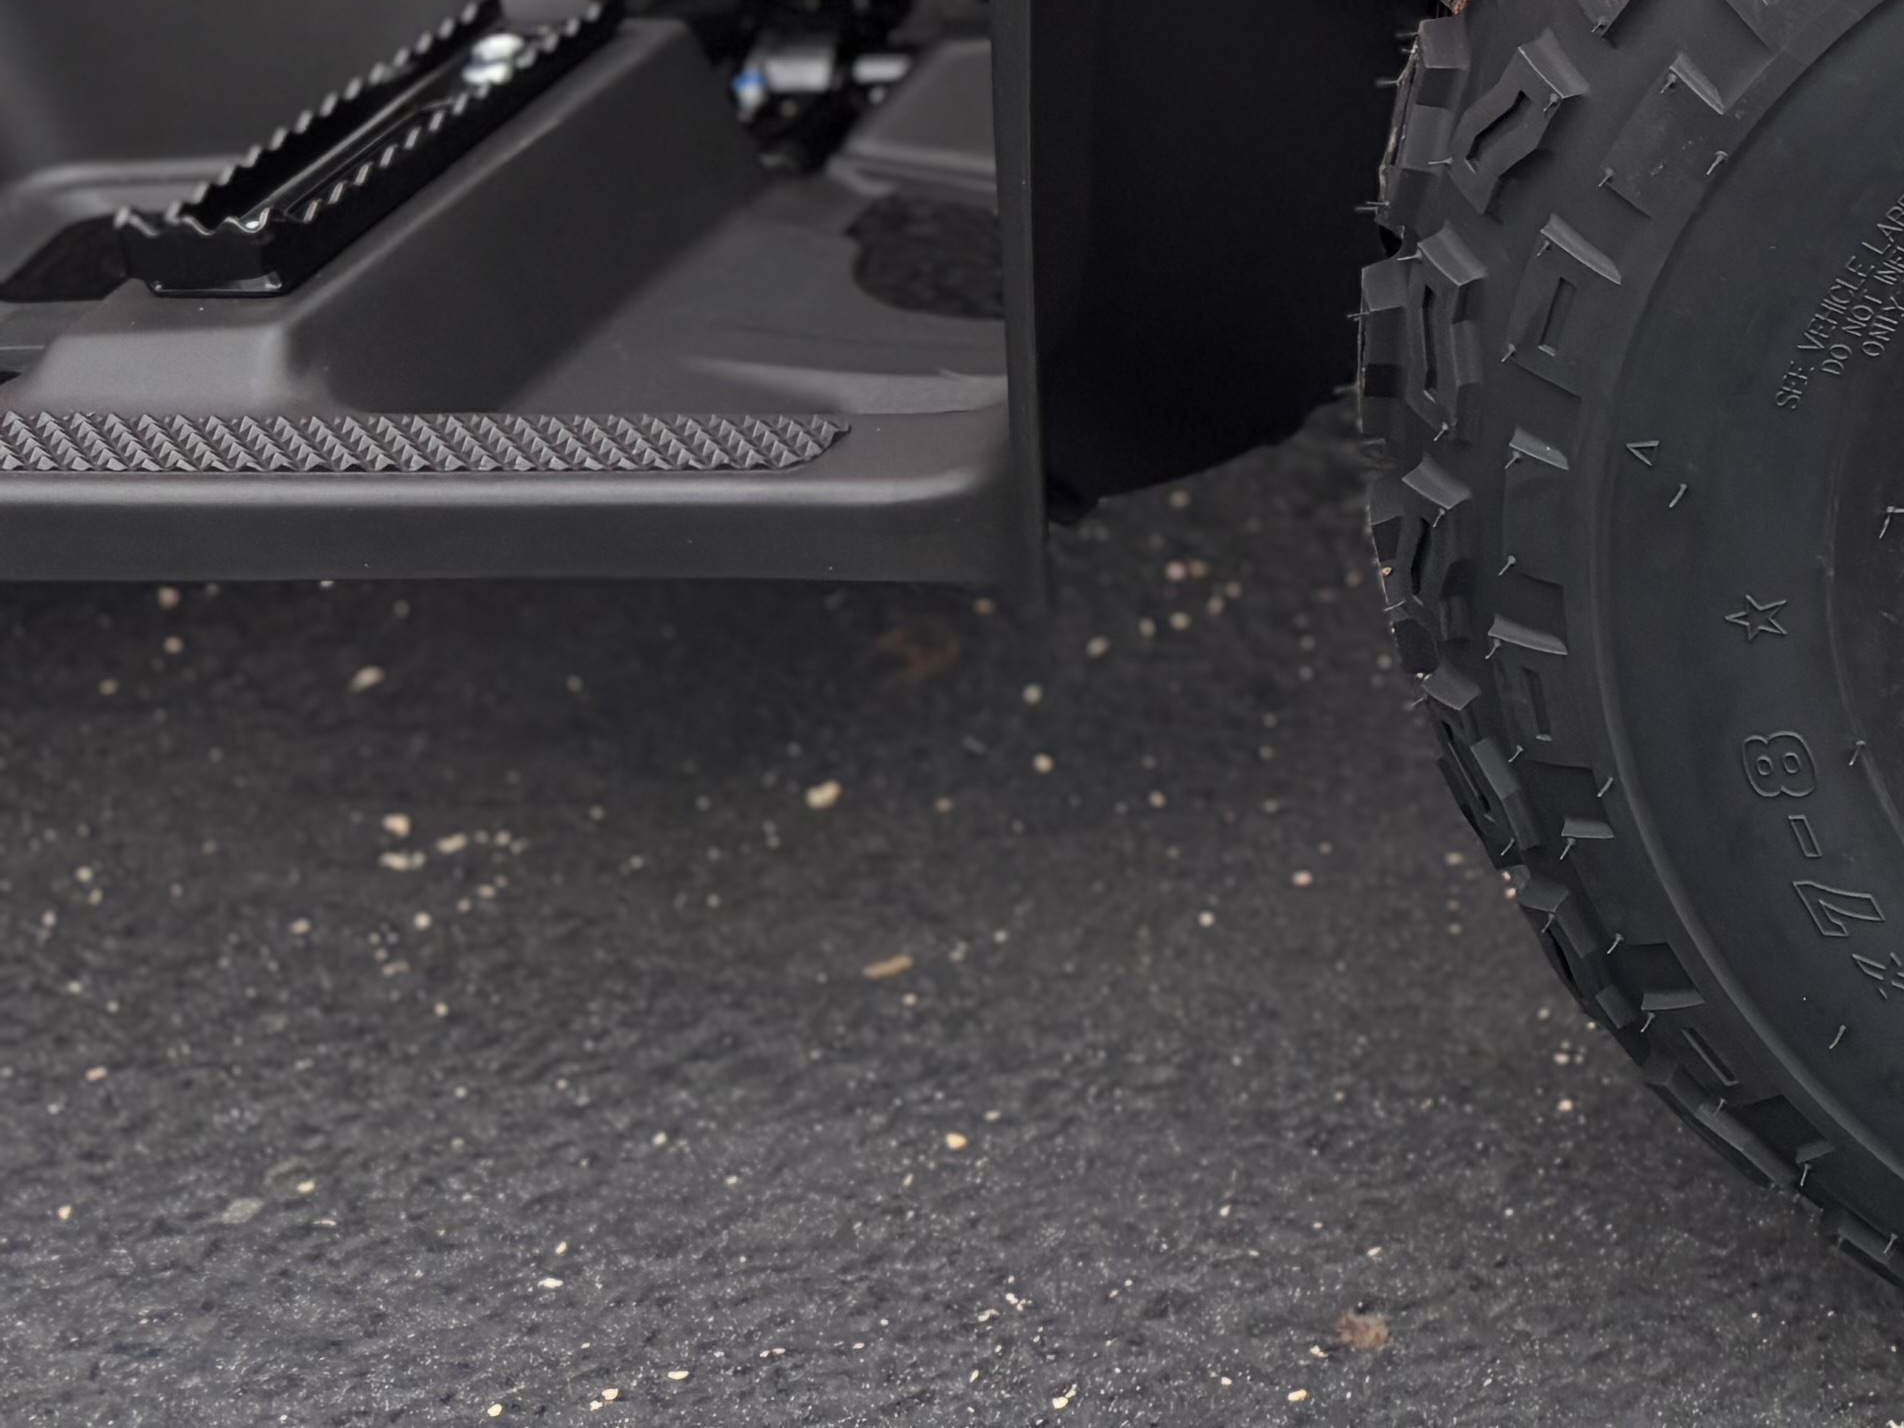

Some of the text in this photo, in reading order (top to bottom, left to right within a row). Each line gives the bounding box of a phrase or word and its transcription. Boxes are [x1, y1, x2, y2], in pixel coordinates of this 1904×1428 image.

[1774, 361, 1813, 408] SEE
[1798, 256, 1873, 353] VEHICLE
[1820, 342, 1854, 374] DO
[1842, 289, 1884, 335] NOT
